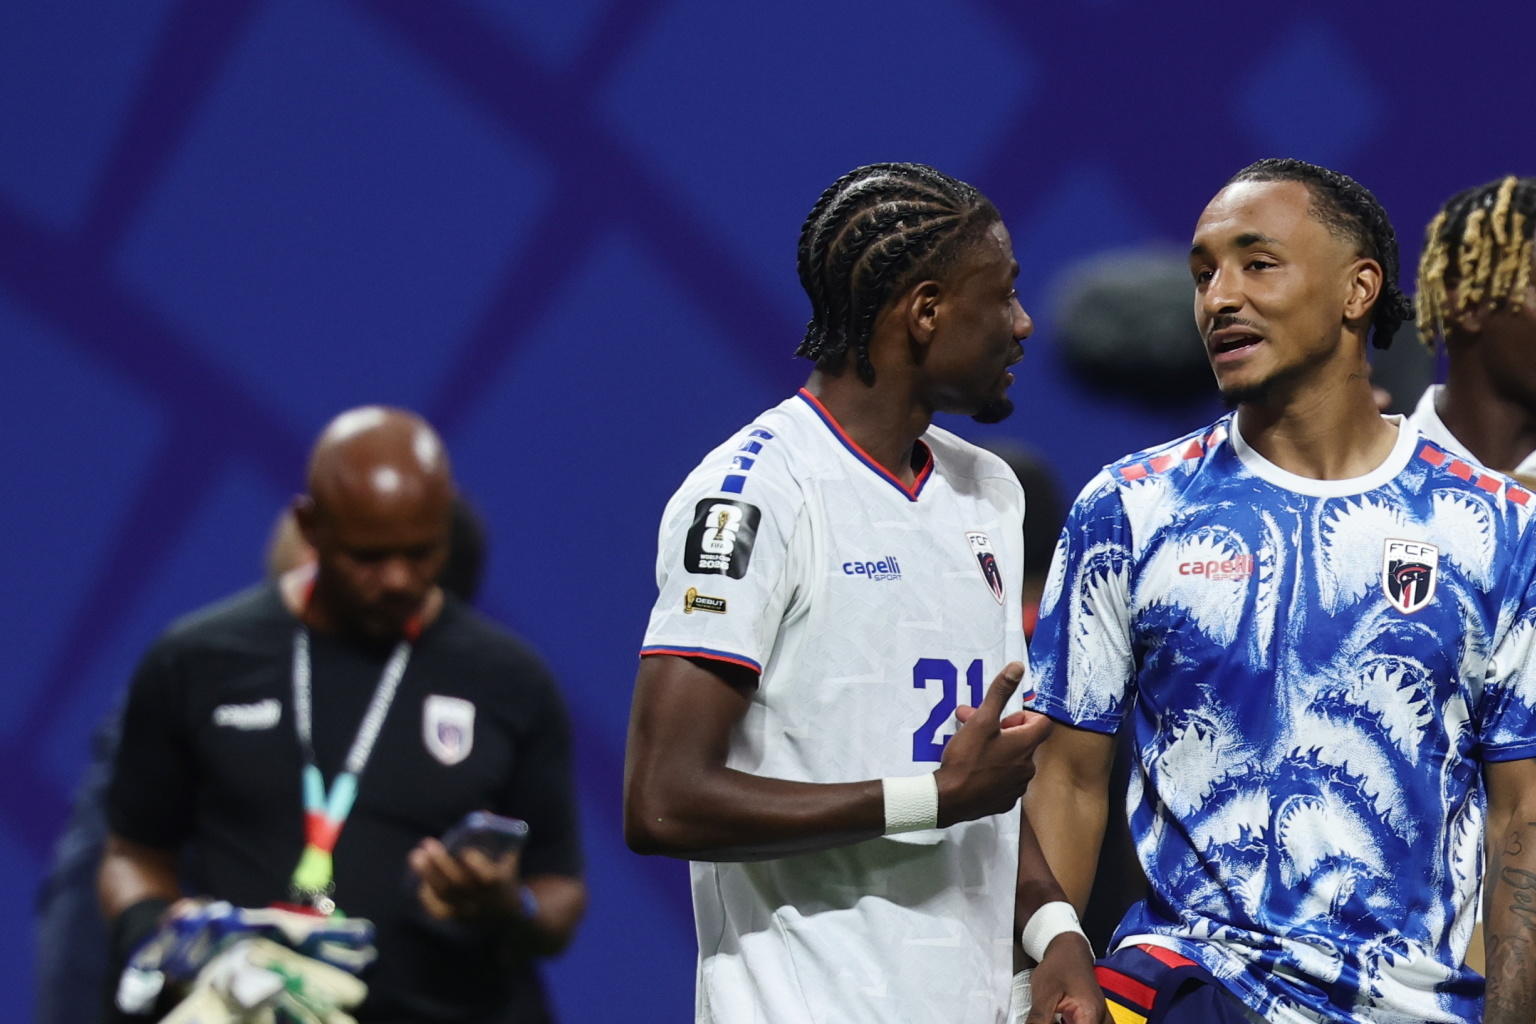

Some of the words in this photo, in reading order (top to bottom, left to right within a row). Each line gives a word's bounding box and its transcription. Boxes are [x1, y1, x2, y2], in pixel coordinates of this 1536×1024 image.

[1389, 543, 1434, 557] FCF
[698, 560, 729, 570] 2026
[842, 556, 901, 579] capelli
[1179, 553, 1254, 579] capelli
[874, 574, 902, 582] SPORT
[696, 597, 723, 607] DEBUT
